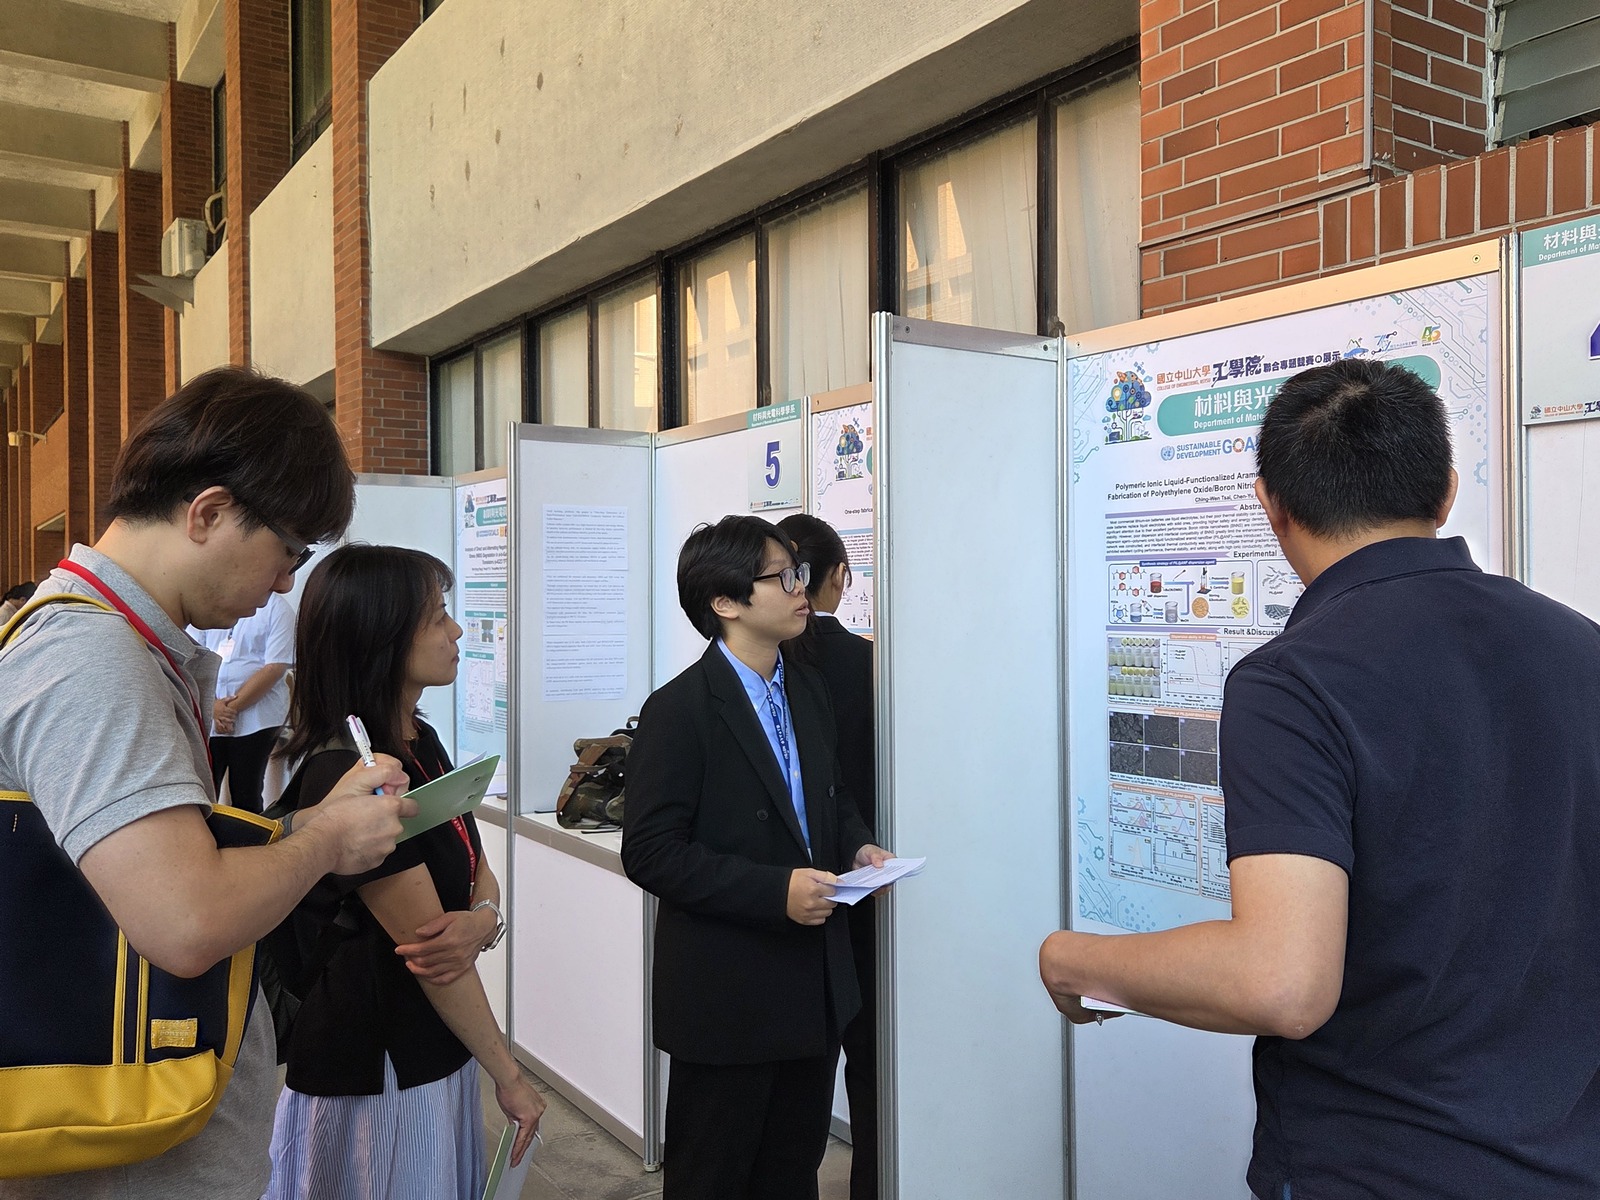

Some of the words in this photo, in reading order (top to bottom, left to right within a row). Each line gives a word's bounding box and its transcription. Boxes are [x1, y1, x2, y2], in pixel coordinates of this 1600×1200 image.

[1544, 224, 1600, 250] 材料與
[1539, 248, 1577, 260] Department
[1195, 385, 1286, 417] 材料與光
[1194, 416, 1234, 429] Department
[1237, 414, 1243, 423] of
[1245, 413, 1265, 422] Mate
[1177, 440, 1221, 451] SUSTAINABLE
[1177, 449, 1221, 460] DEVELOPMENT
[766, 441, 780, 487] 5
[1116, 483, 1145, 491] Polymeric
[1164, 473, 1235, 487] Liquid-Functionalized
[1237, 471, 1260, 479] Arami
[1108, 491, 1141, 500] Fabrication
[1151, 487, 1191, 497] Polyethylene
[1193, 484, 1235, 493] Oxide/Boron
[1234, 550, 1277, 558] Experimental
[1246, 628, 1283, 636] &Discussi
